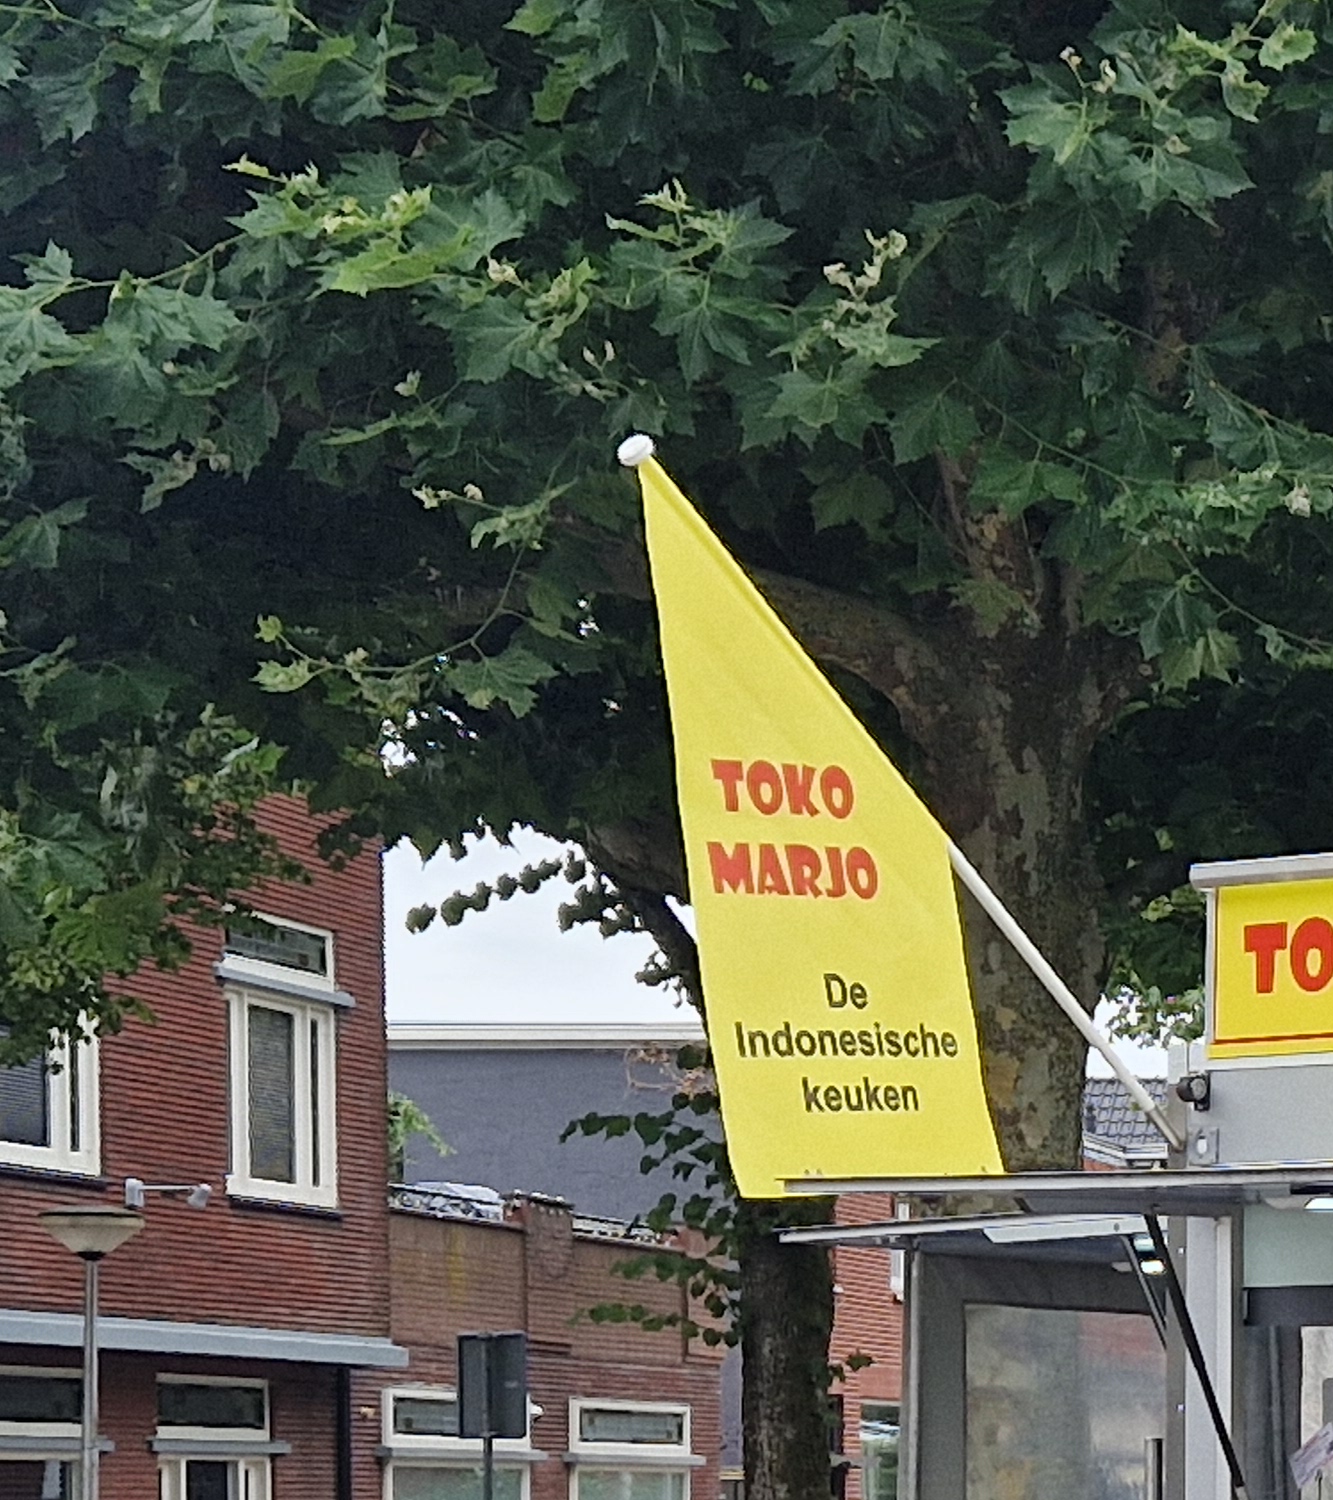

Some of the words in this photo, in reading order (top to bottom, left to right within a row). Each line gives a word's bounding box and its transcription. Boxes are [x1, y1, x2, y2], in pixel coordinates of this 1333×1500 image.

[710, 758, 855, 820] TOKO
[706, 840, 878, 900] MARJO
[824, 973, 869, 1010] De
[735, 1022, 959, 1059] Indonesische
[802, 1077, 920, 1113] keuken
